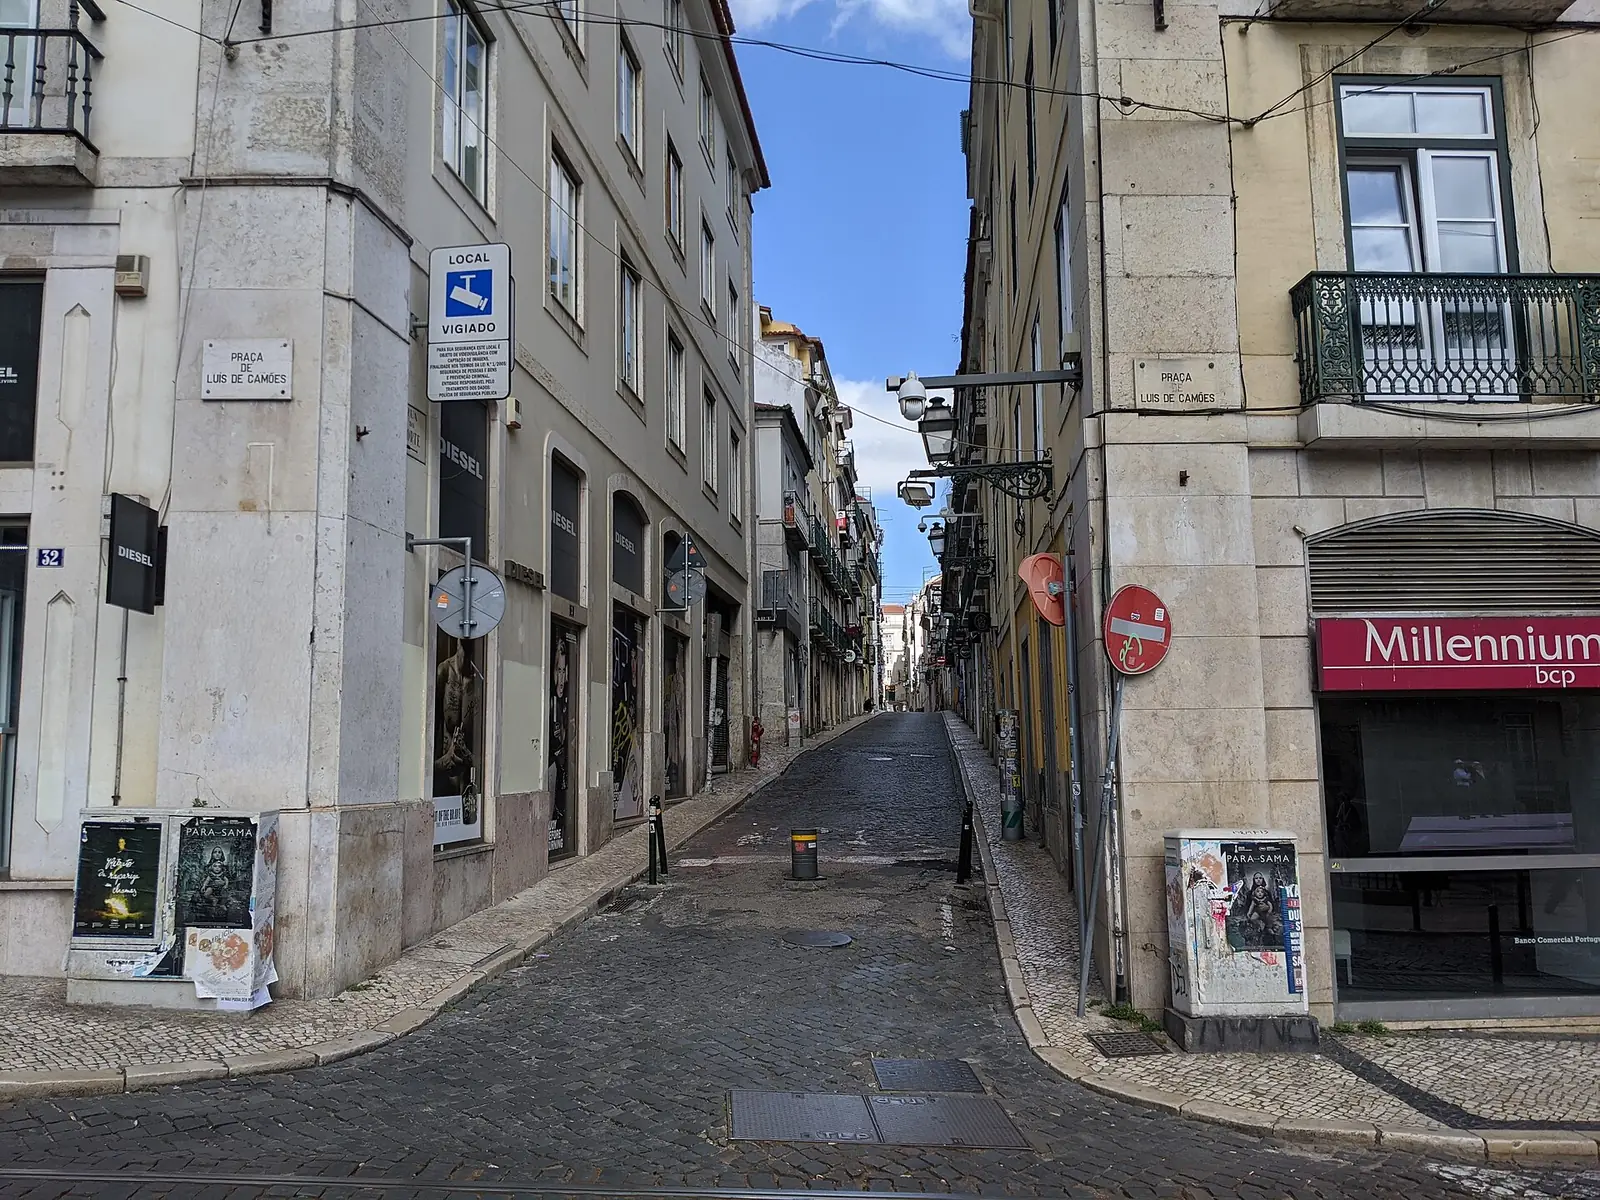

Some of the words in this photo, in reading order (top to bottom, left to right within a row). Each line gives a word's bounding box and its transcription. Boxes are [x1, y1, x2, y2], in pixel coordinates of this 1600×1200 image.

[449, 253, 490, 264] LOCAL
[442, 323, 496, 334] VIGIADO
[231, 353, 263, 363] PRAÇA
[241, 363, 252, 372] DE
[231, 374, 243, 383] DE
[1161, 373, 1192, 383] PRAÇA
[1164, 394, 1174, 402] DE
[1179, 392, 1215, 402] CAMÕES
[440, 436, 483, 480] DIESEL
[552, 510, 576, 536] IESEL
[615, 532, 636, 555] DIESEL
[41, 550, 59, 565] 32
[118, 546, 153, 567] DIESEL
[505, 560, 546, 590] DIESEL
[1361, 619, 1600, 662] Millennium
[1536, 666, 1576, 688] bcp
[186, 828, 215, 836] PARA
[222, 828, 252, 837] SAMA
